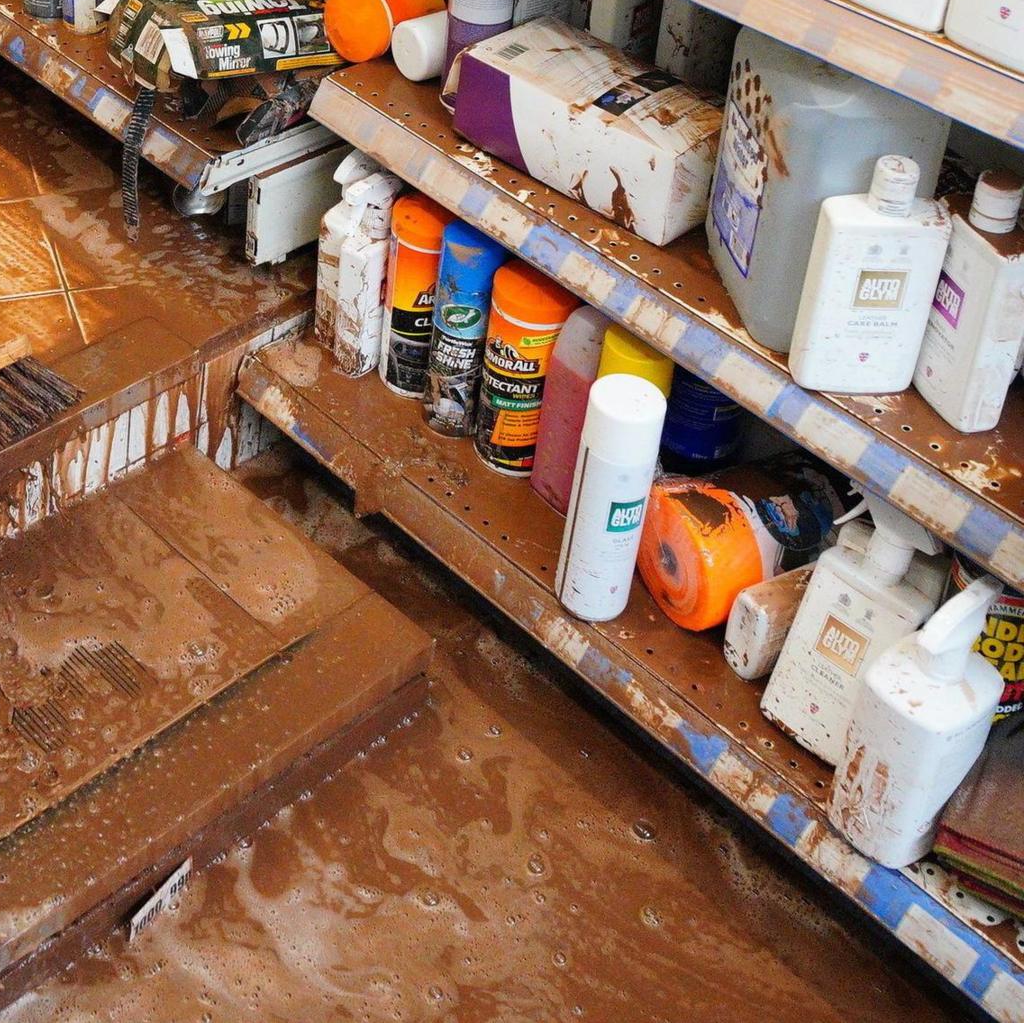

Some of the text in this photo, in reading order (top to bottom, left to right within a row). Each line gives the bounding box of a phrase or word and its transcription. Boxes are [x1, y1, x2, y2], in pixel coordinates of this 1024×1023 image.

[205, 43, 241, 60] Towing
[219, 56, 252, 71] Mirror
[847, 320, 899, 328] CARE BALM
[437, 342, 476, 359] FRESH
[436, 352, 474, 370] SHINE
